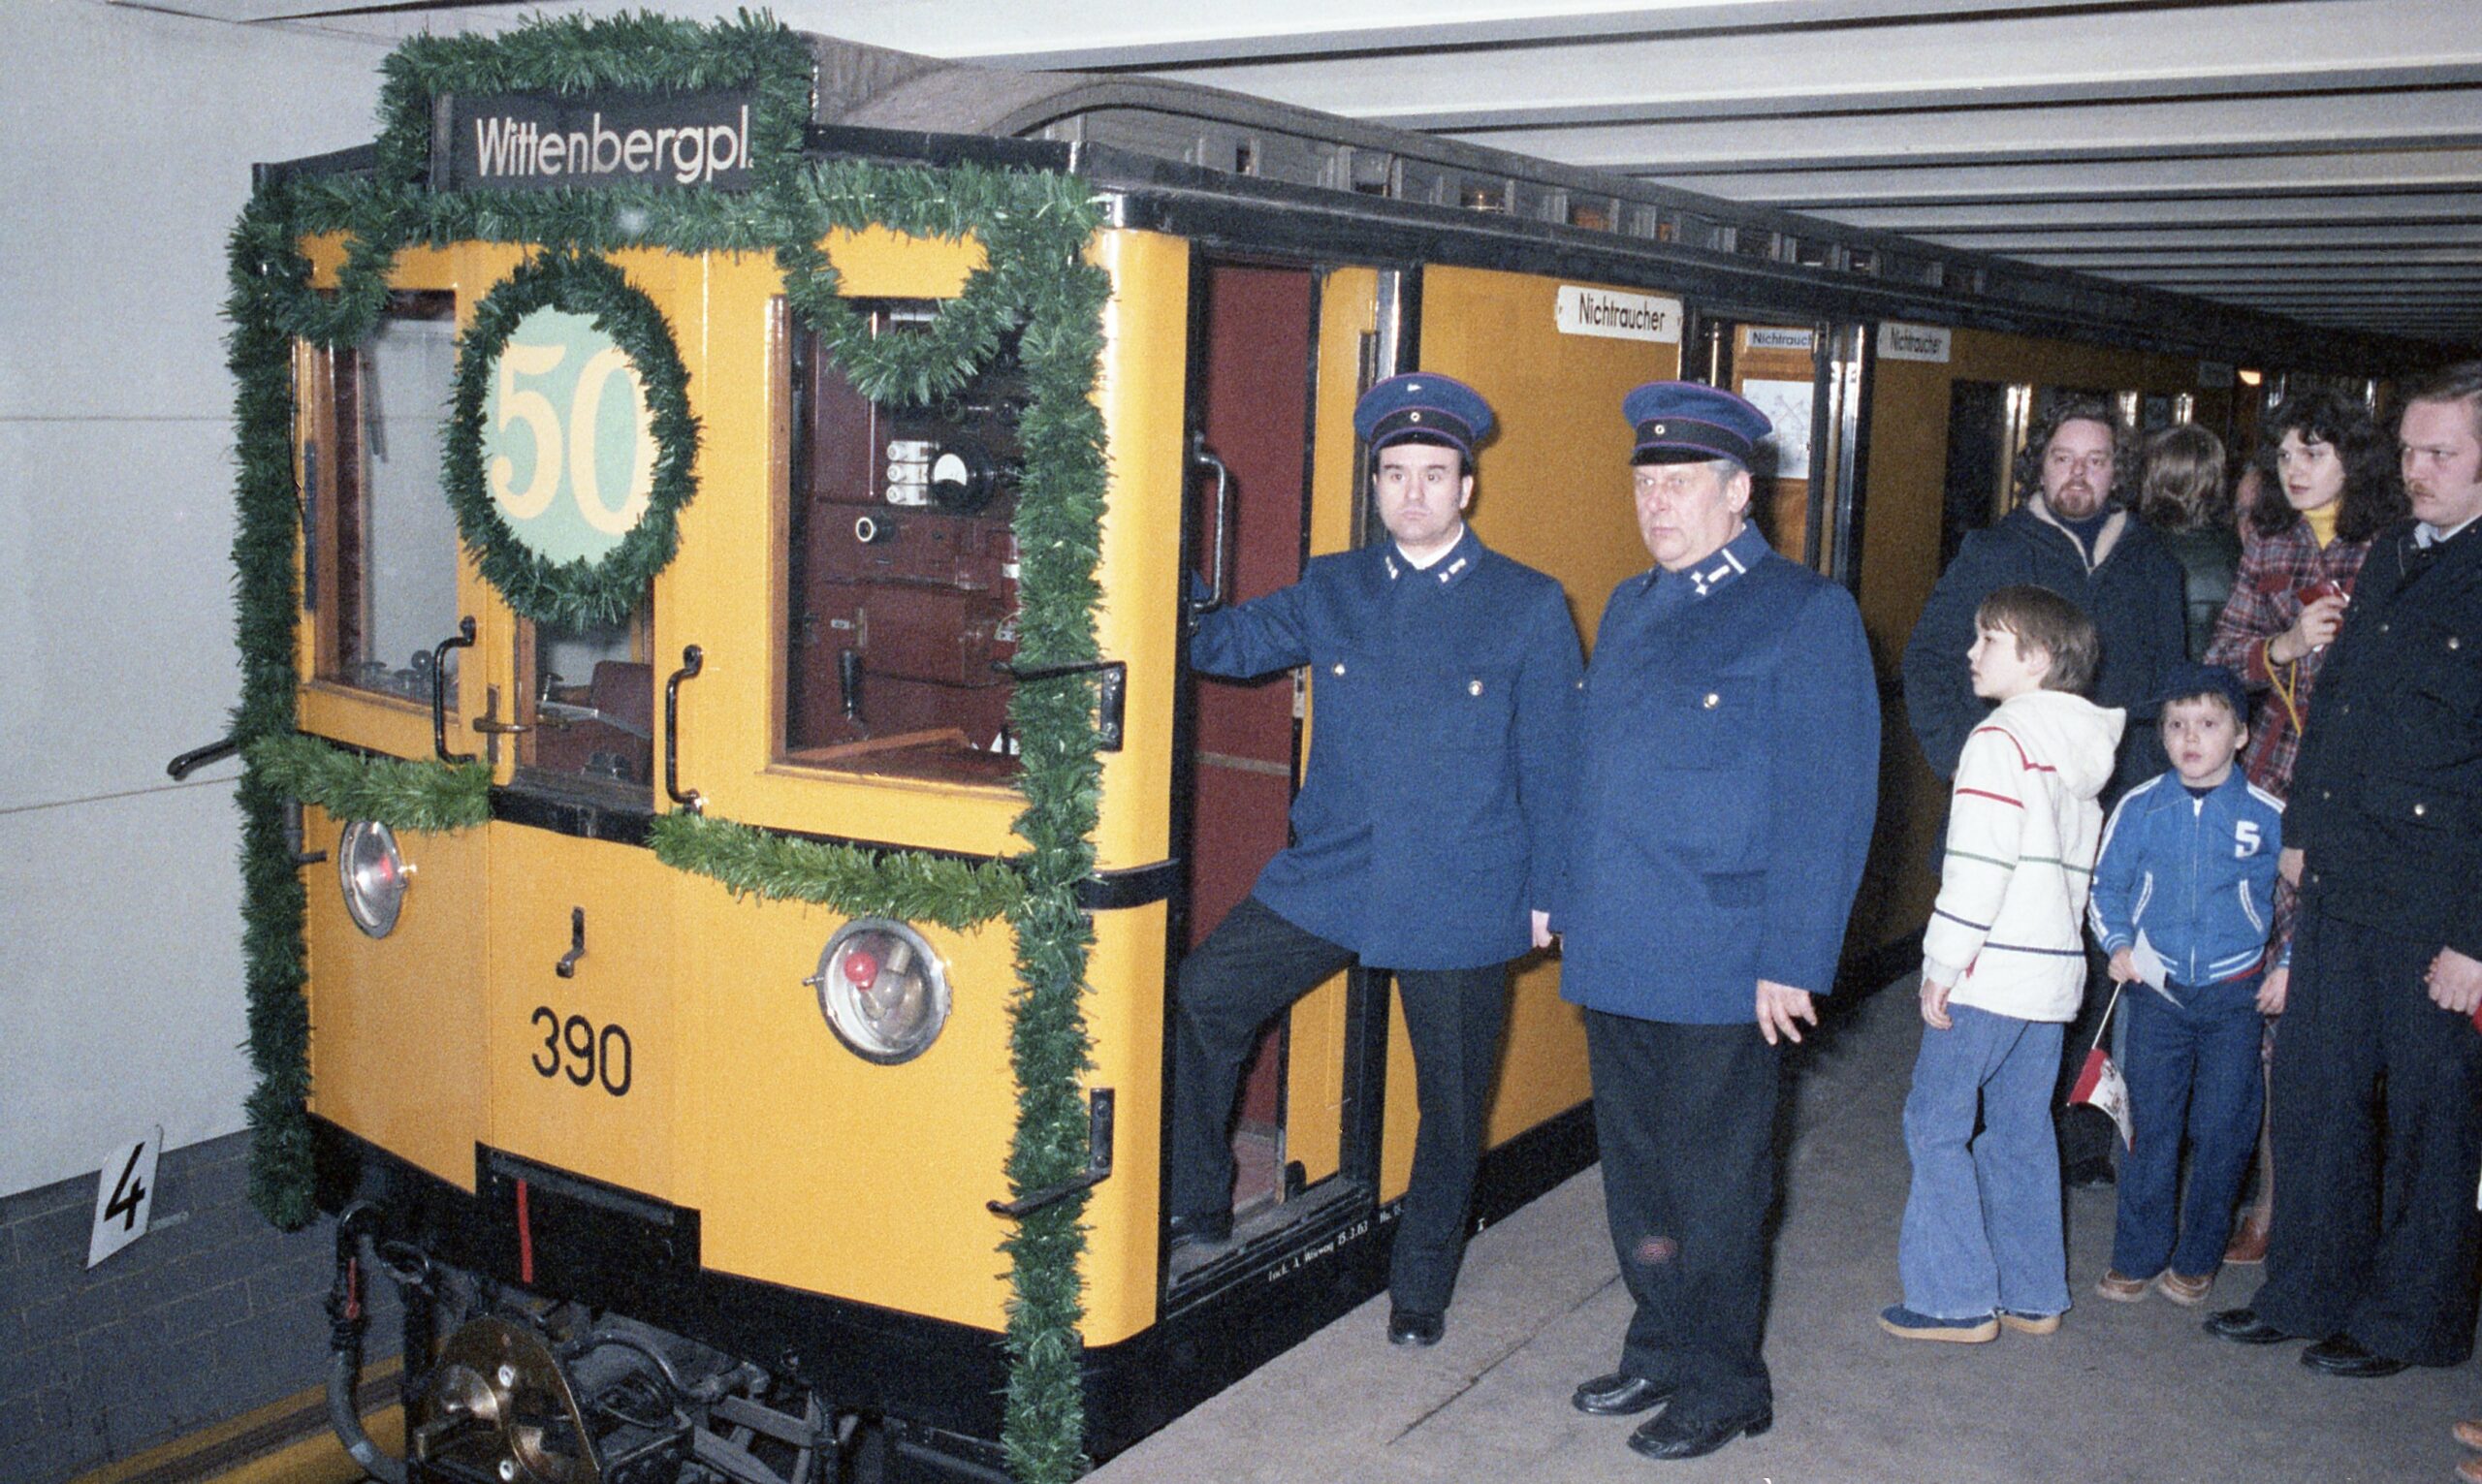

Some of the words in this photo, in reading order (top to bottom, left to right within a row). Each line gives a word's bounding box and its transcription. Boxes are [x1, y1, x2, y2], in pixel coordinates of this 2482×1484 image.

[1579, 293, 1666, 332] Nichtraucher
[1891, 327, 1942, 354] Nichtraucher
[491, 342, 659, 536] 50
[2235, 820, 2261, 858] 5
[531, 1005, 632, 1097] 390
[104, 1141, 146, 1232] 4
